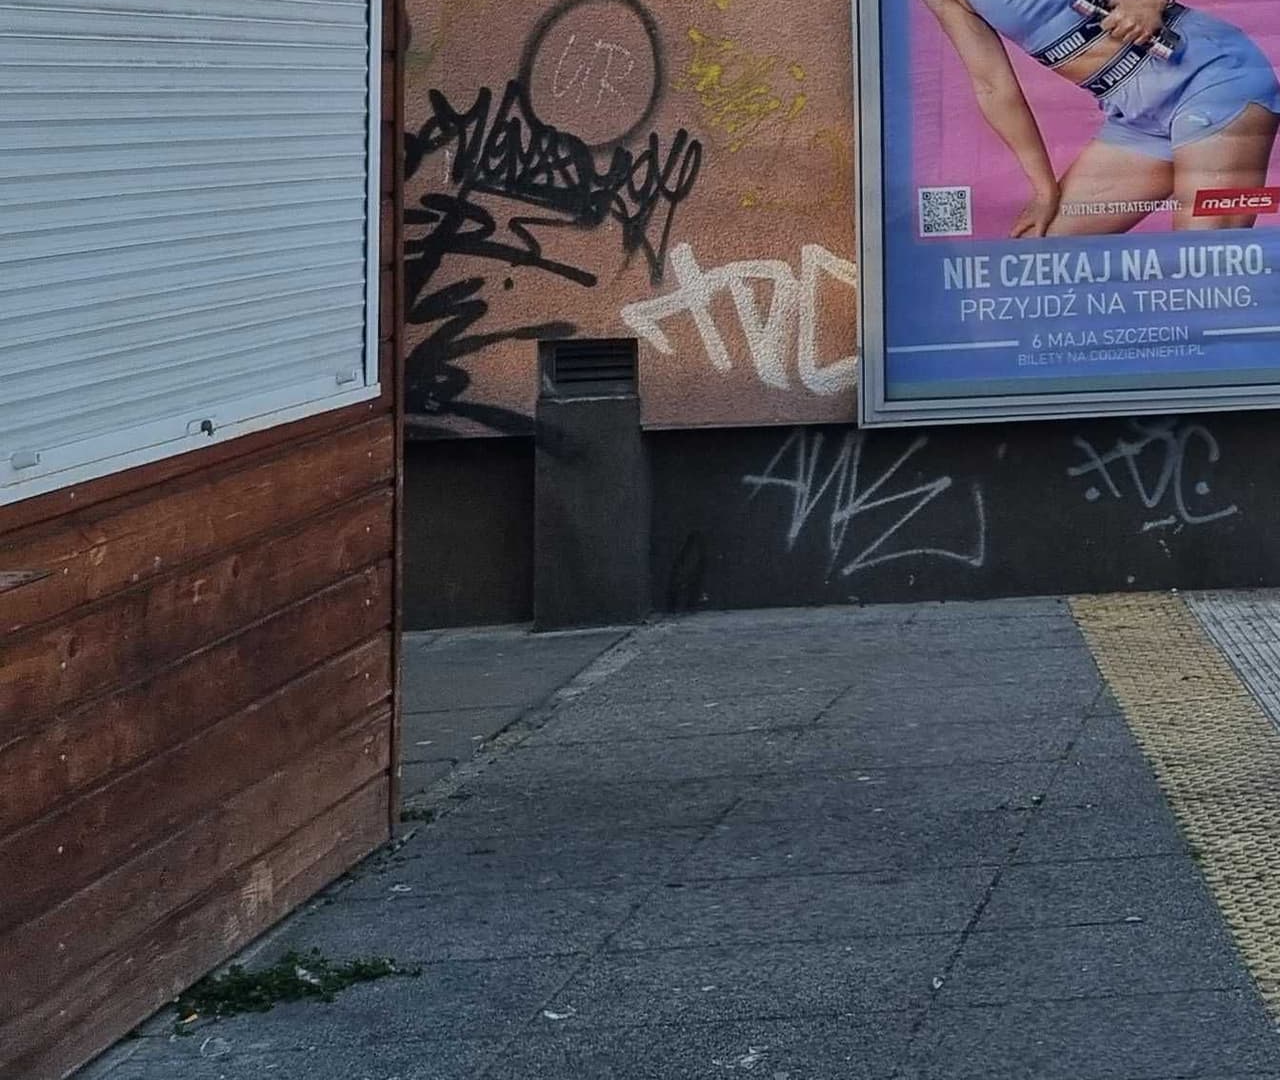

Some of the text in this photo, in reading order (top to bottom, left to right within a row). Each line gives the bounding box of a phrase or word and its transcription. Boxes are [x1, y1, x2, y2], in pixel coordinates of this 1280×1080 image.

[1045, 31, 1087, 63] PUMA
[1103, 50, 1141, 87] PUMA
[1061, 202, 1106, 217] PARTNER
[1201, 193, 1273, 210] martes
[943, 243, 1273, 290] NIE CZEKAJ NA JUTRO.
[960, 284, 1259, 324] PRZYJDŹ NA TRENING.
[1031, 324, 1189, 349] 6 MAJA SZCZECIN
[1017, 351, 1061, 367] BILETY
[1066, 350, 1086, 364] NA
